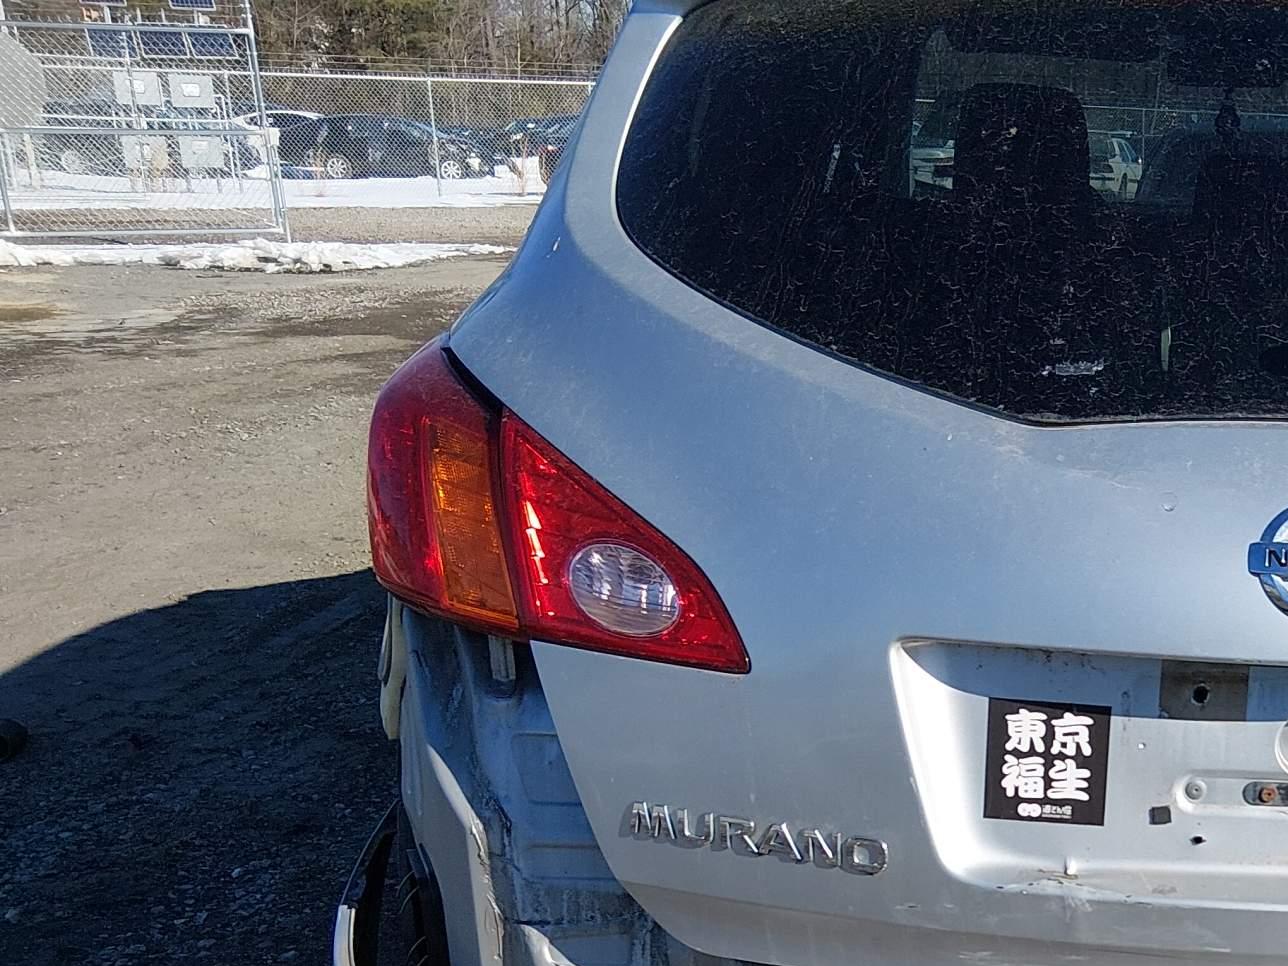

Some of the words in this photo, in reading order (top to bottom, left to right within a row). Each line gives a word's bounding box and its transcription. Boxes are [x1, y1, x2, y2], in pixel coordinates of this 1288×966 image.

[1004, 708, 1095, 757] 東京
[1000, 754, 1092, 801] 福生
[630, 800, 889, 875] MURANO
